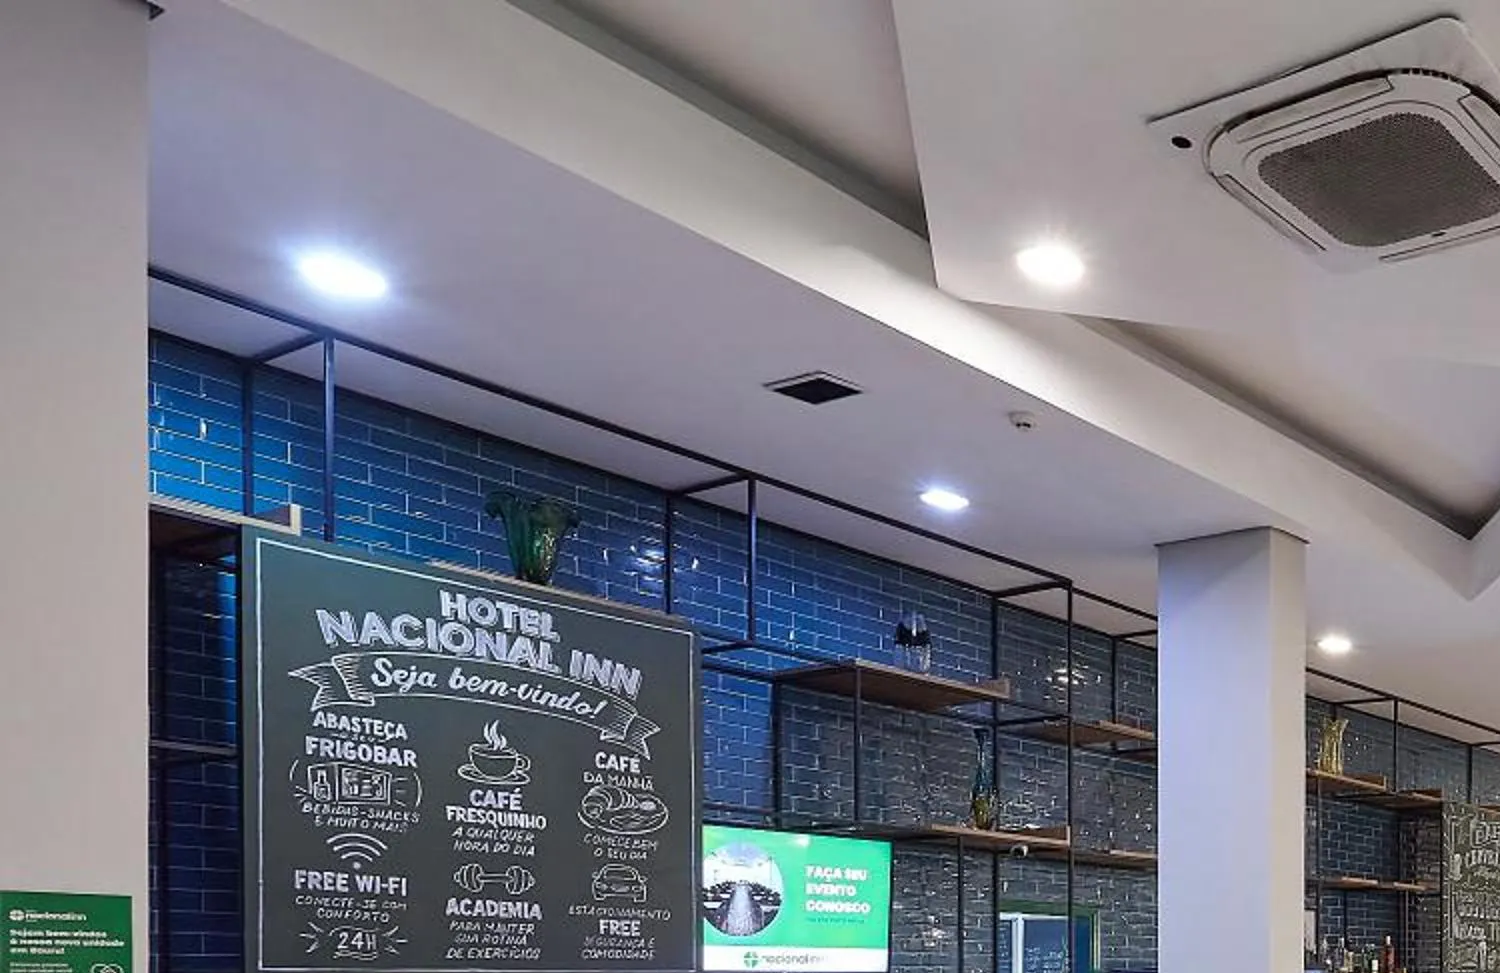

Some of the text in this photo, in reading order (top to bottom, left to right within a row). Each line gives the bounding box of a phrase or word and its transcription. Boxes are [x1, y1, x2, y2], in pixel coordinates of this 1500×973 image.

[439, 589, 561, 643] HOTEL
[316, 609, 643, 701] NACIONAL INN
[371, 657, 608, 719] Seja bem-vindo!
[305, 735, 418, 768] FRIGOBAR
[595, 751, 641, 773] CAFÉ
[583, 771, 604, 784] DA
[469, 787, 523, 811] CAFÉ
[327, 815, 369, 830] MUITO
[445, 805, 547, 830] FRESQUINHO
[452, 826, 535, 843] A QUALQUER
[453, 839, 536, 857] HORA DO DIA
[805, 864, 843, 883] FAÇA
[294, 869, 407, 898] FREE WI-FI
[805, 882, 857, 898] EVENTO
[316, 907, 390, 923] CONFORTO
[446, 897, 543, 921] ACADEMIA
[805, 899, 871, 915] CONOSCO
[449, 920, 481, 932] PARA
[599, 919, 641, 937] FREE
[337, 931, 377, 951] 24H
[446, 947, 465, 959] DE
